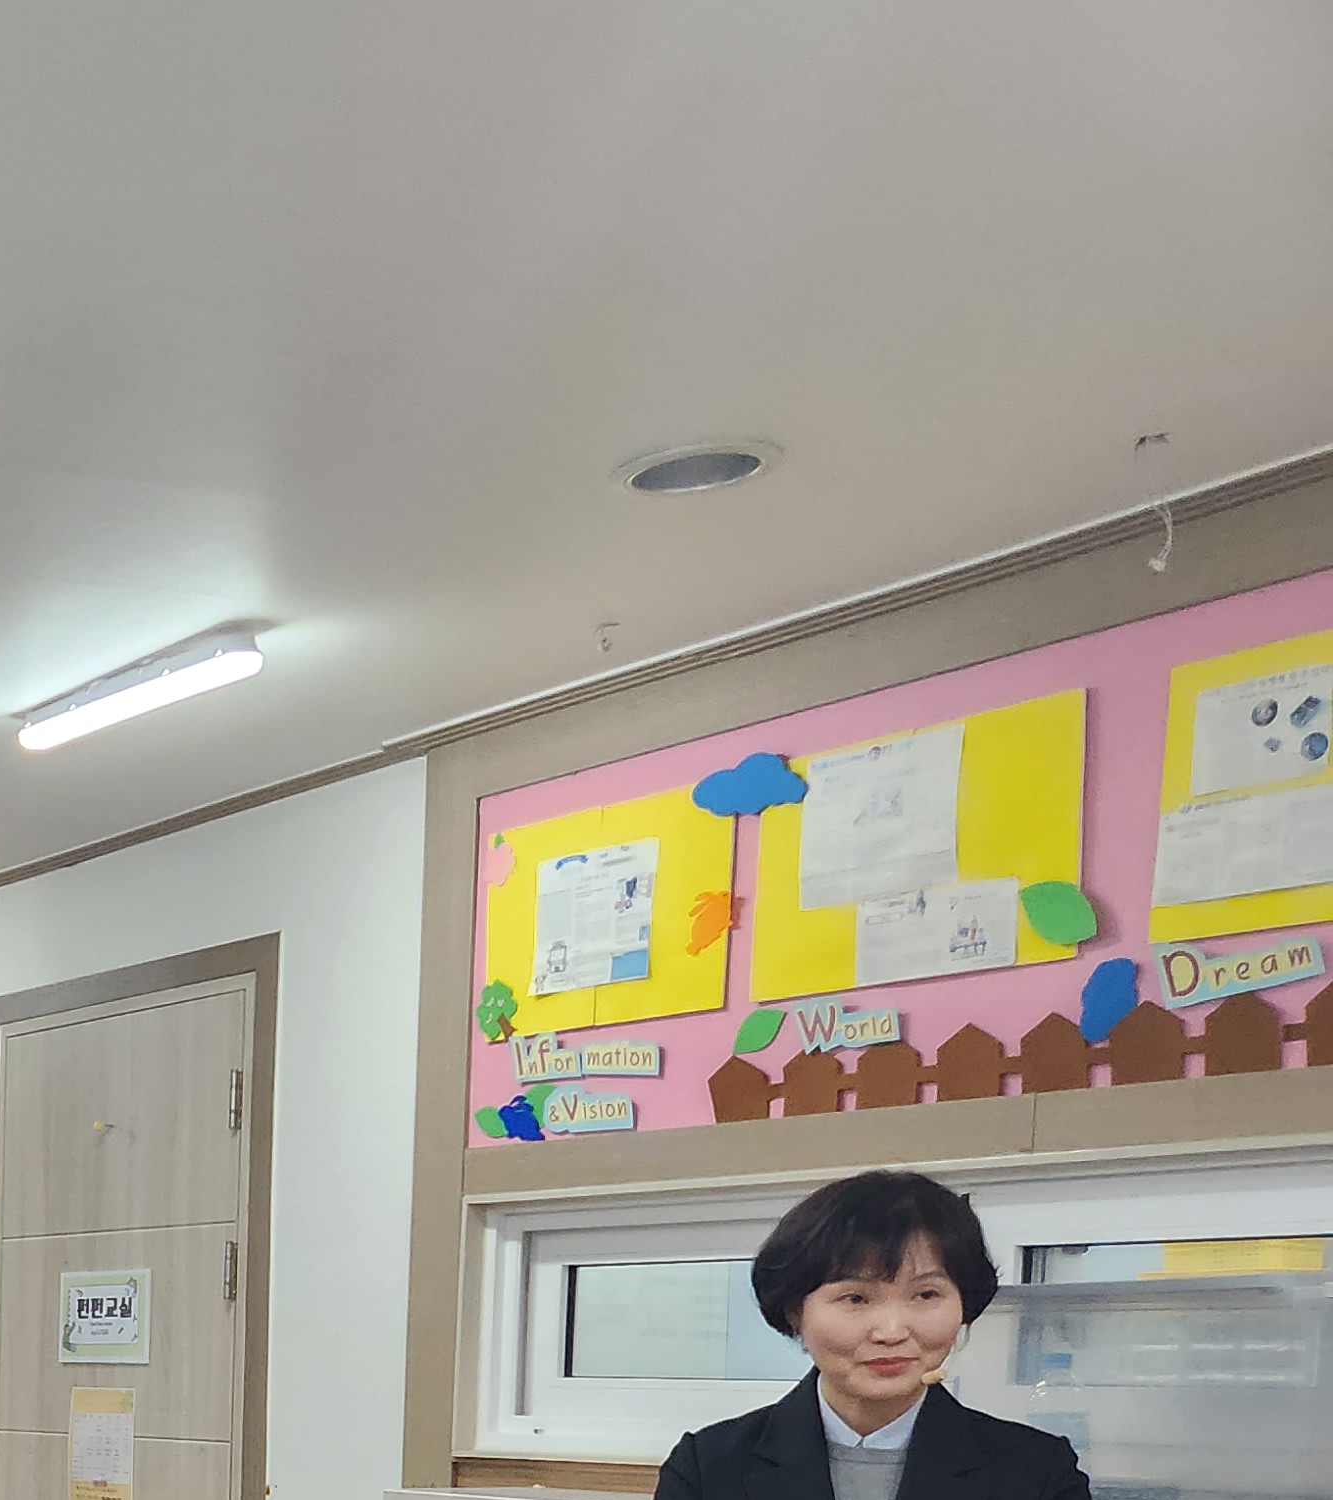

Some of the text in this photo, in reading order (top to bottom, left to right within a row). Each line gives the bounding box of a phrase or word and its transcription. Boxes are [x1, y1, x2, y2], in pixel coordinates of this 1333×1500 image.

[1162, 946, 1312, 998] Dream
[797, 1004, 893, 1044] World
[76, 1296, 133, 1320] 펀펀교실
